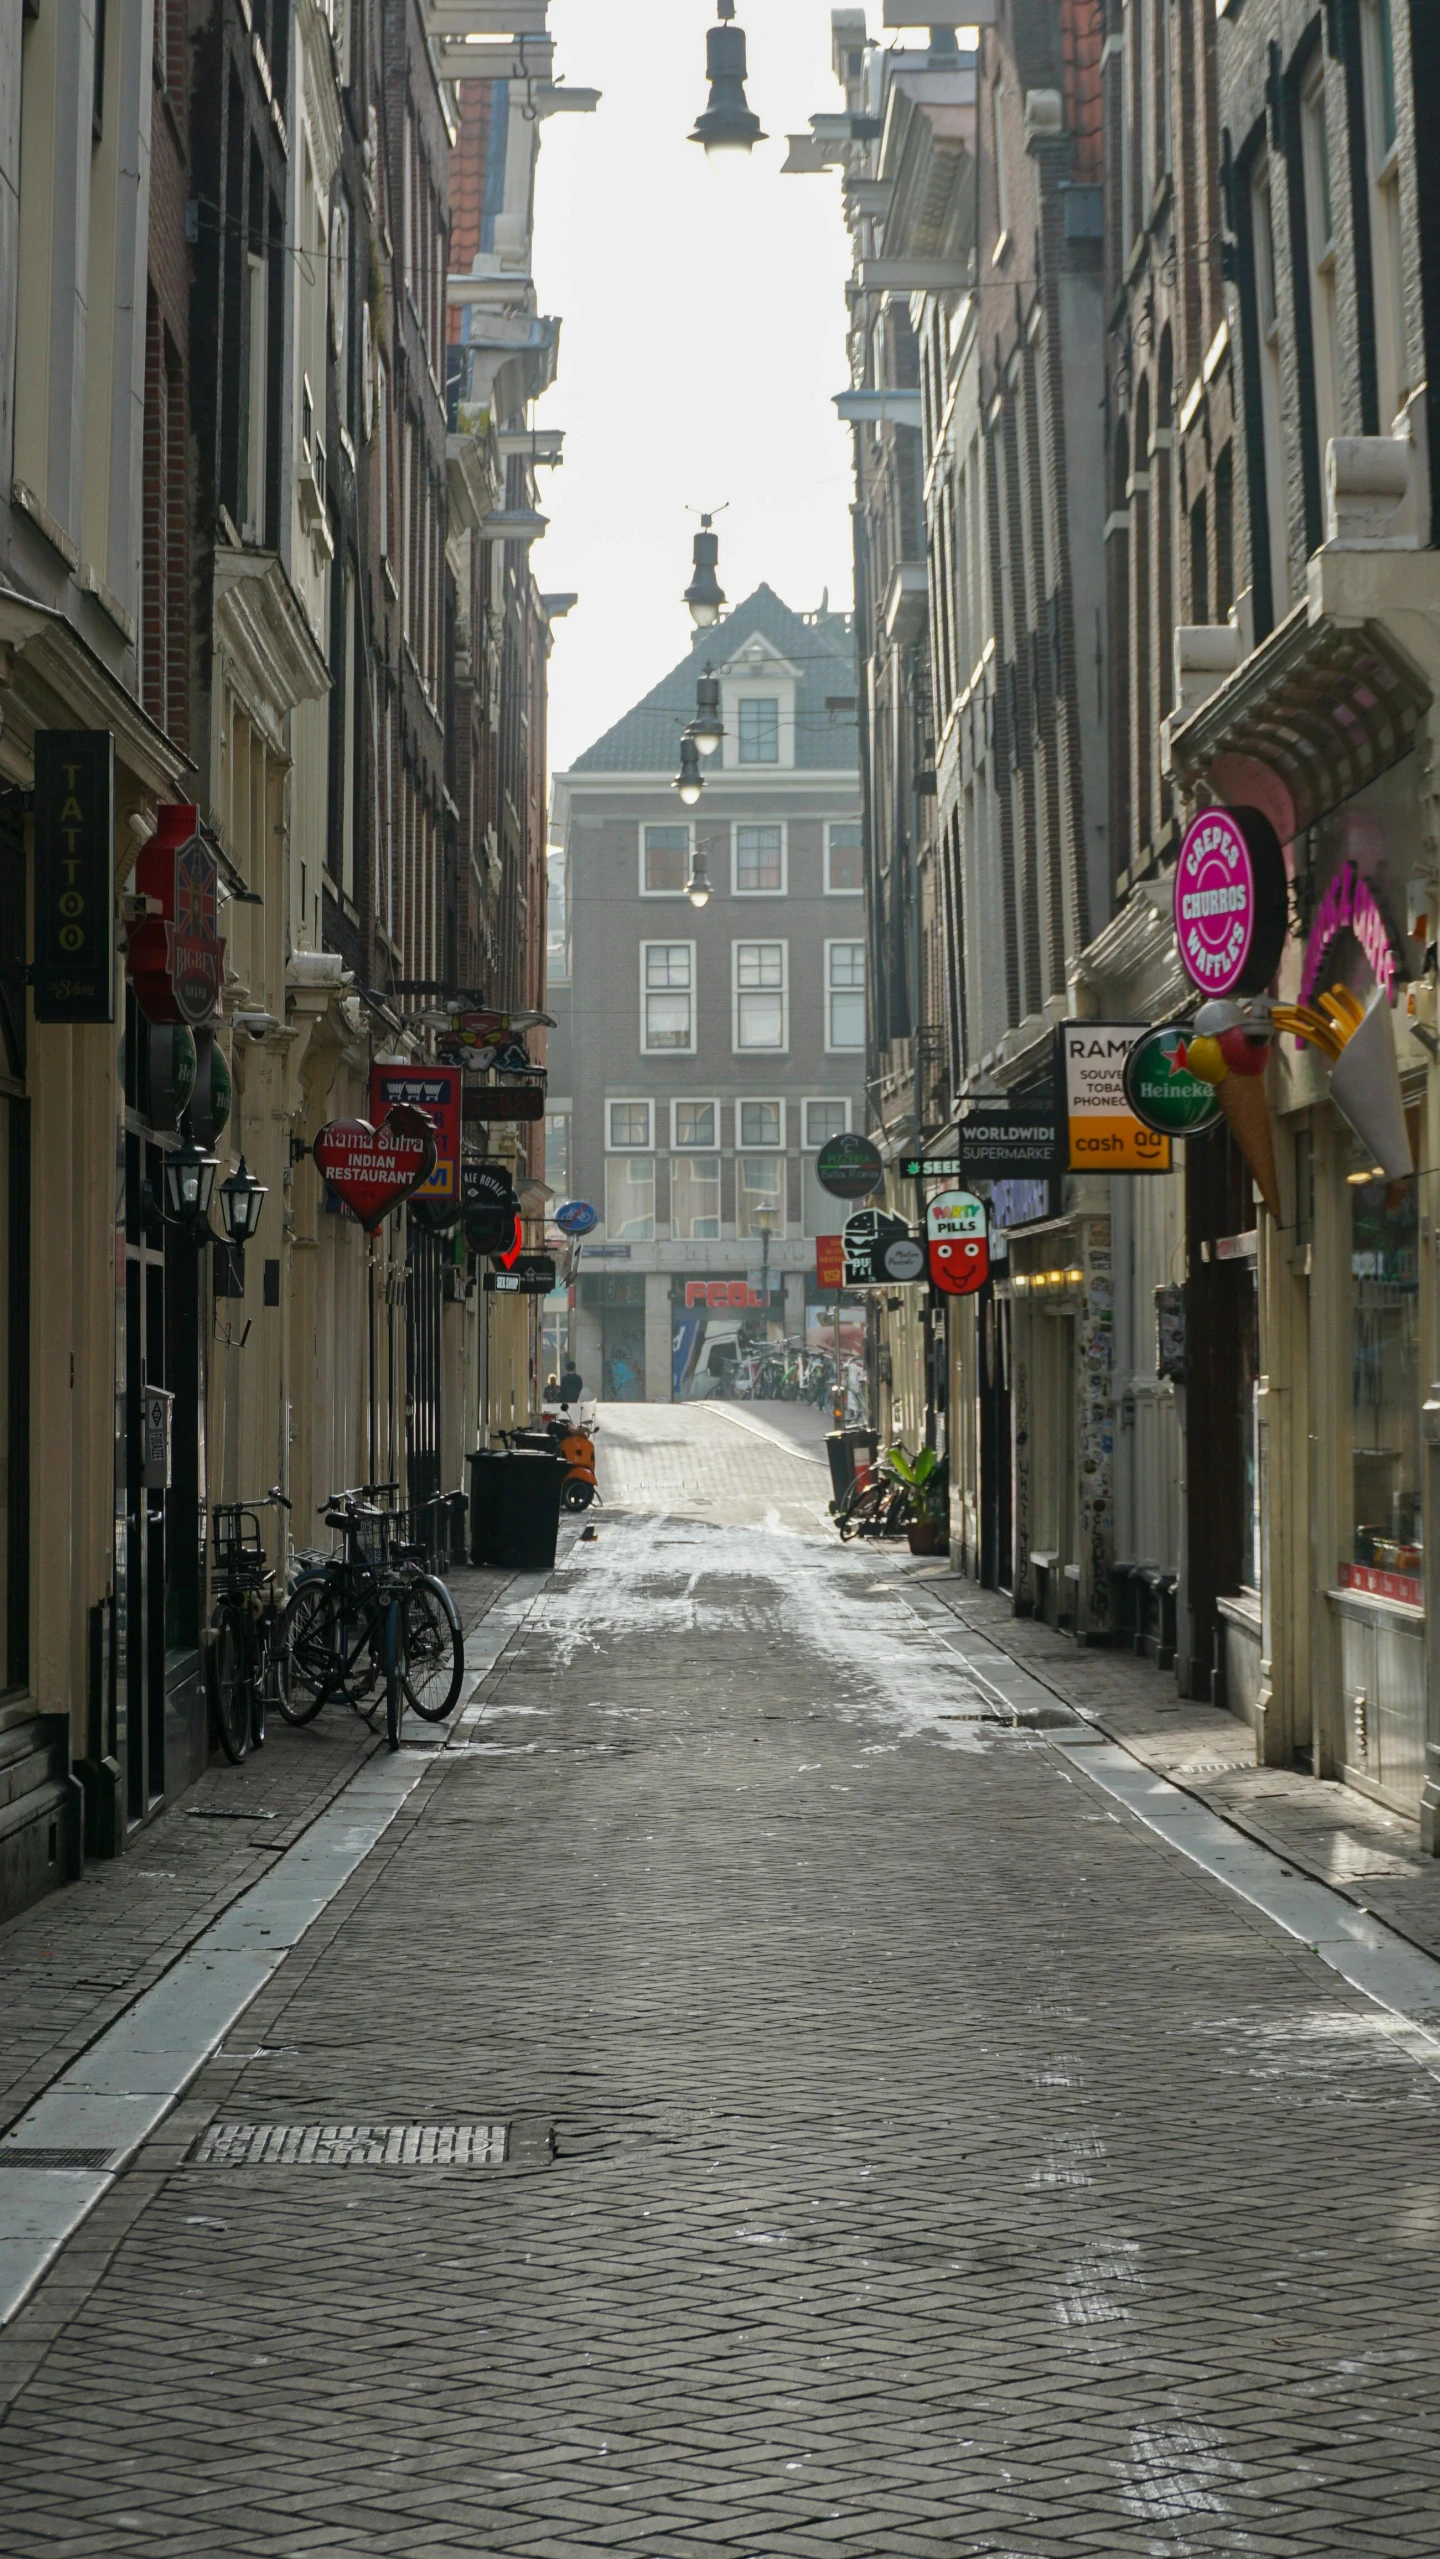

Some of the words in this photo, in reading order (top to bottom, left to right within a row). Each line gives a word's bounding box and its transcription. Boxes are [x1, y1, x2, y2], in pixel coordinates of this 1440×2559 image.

[58, 764, 84, 951] TATTOO
[1186, 826, 1240, 876] CREPES
[1182, 884, 1246, 919] CHURROS
[1187, 922, 1245, 978] WAFFLES
[1080, 1070, 1123, 1080] SOUVE
[1086, 1083, 1124, 1093] TOBA
[1140, 1082, 1216, 1098] Heineke
[1073, 1097, 1128, 1107] PHONEC
[322, 1128, 373, 1149] Kama
[378, 1131, 423, 1153] Sutra
[1075, 1133, 1123, 1151] cash
[348, 1153, 395, 1169] INDIAN
[326, 1166, 415, 1185] RESTAURANT
[480, 1174, 507, 1197] ROYALE
[932, 1204, 980, 1220] PARTY
[938, 1221, 975, 1233] PILLS
[496, 1276, 505, 1289] SEX
